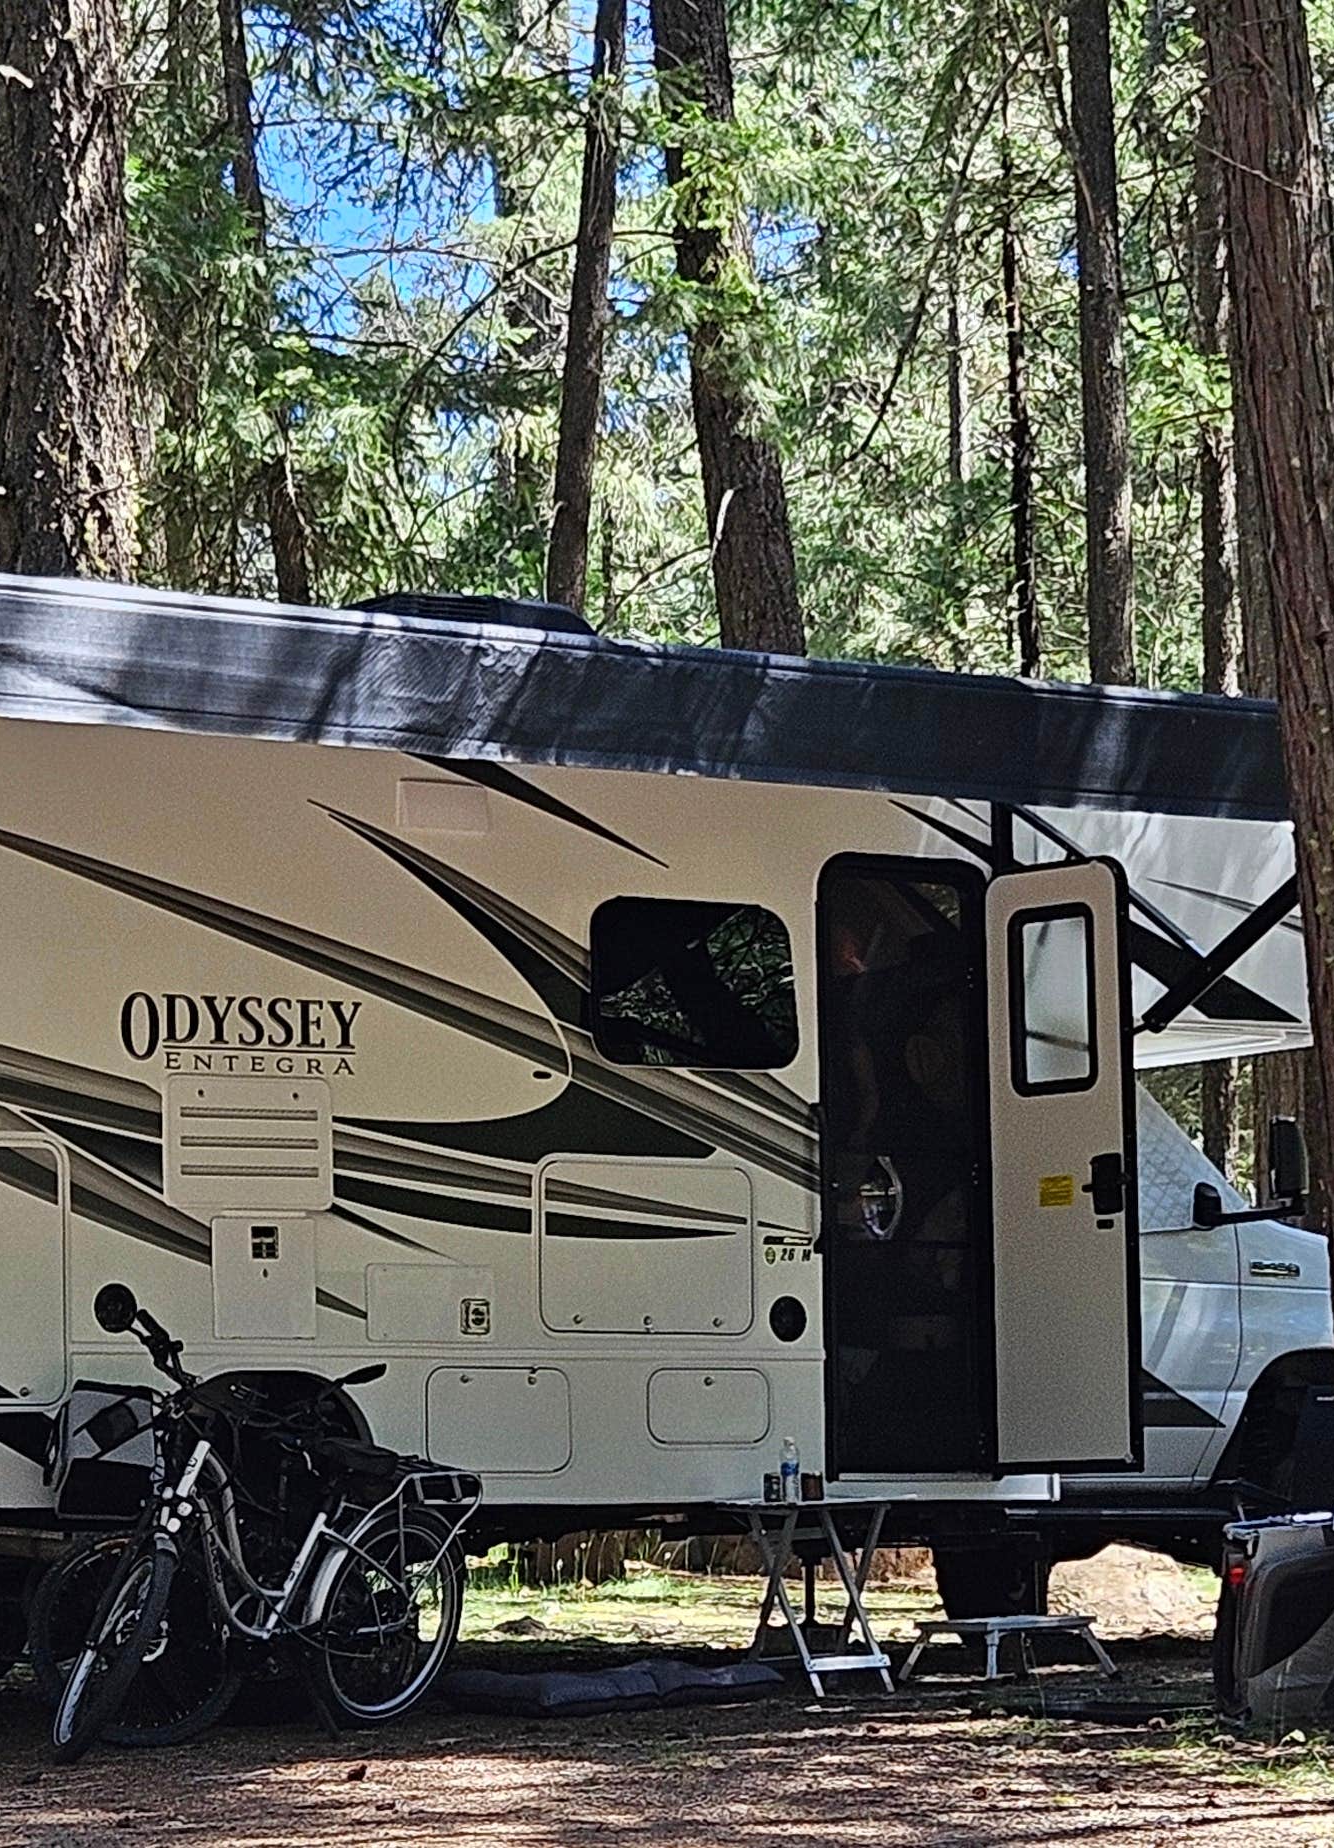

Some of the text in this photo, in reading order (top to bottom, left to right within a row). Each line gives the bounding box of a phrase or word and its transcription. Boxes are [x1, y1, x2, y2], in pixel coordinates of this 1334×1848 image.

[120, 991, 363, 1061] ODYSSEY
[164, 1052, 356, 1076] ENTEGRA
[780, 1247, 796, 1262] 26
